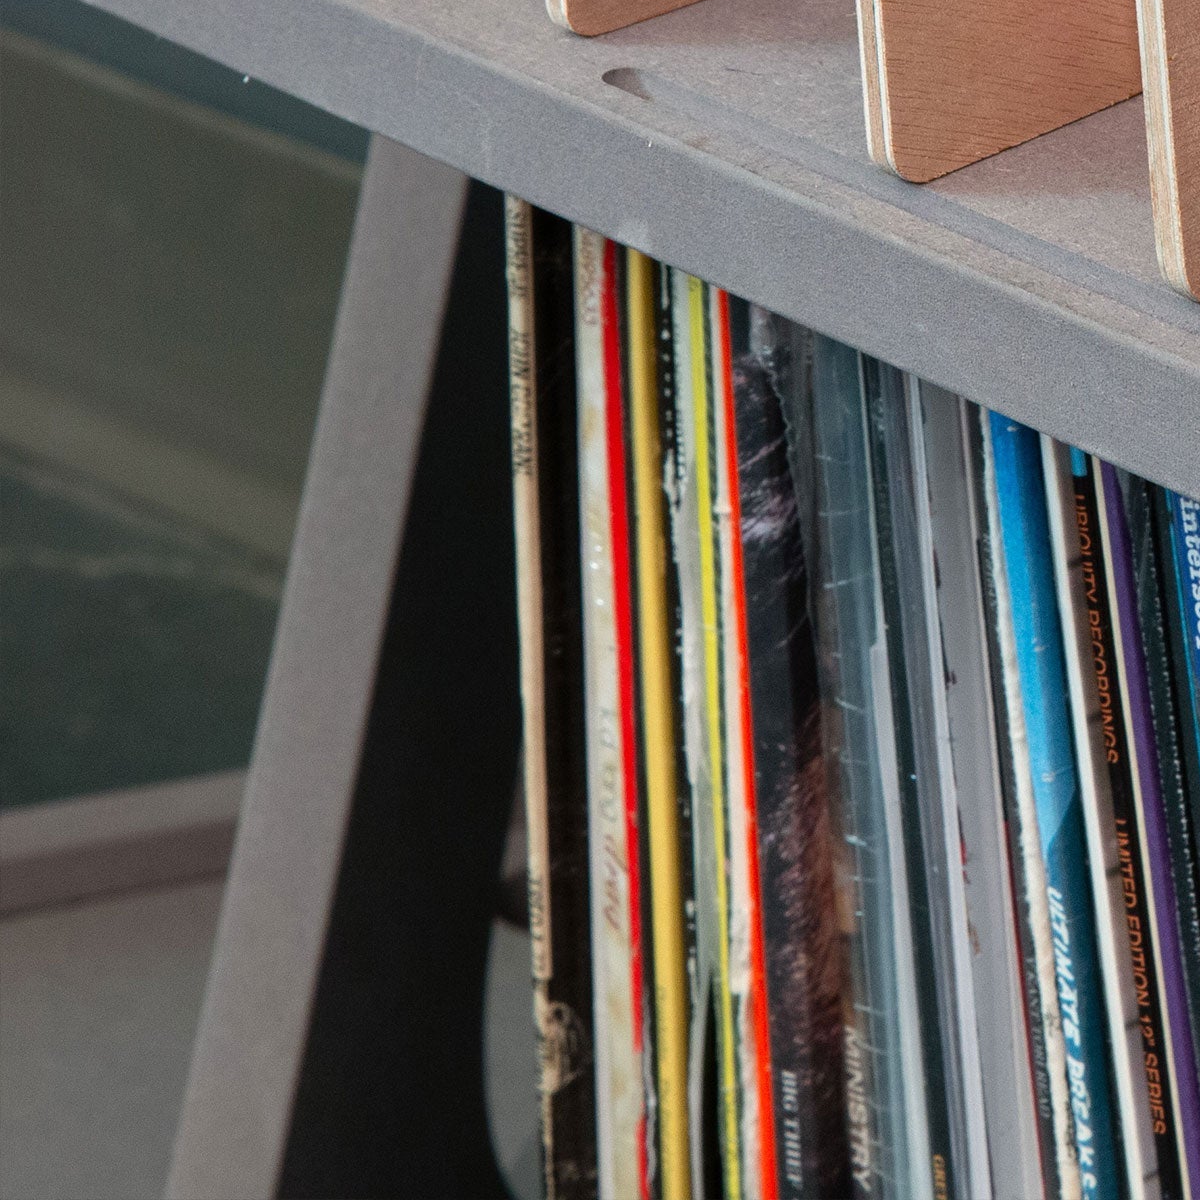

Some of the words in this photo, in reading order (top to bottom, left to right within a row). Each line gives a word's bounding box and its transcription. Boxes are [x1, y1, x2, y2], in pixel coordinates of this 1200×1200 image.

[1088, 609, 1119, 764] RECORDINGS
[1047, 886, 1081, 1047] ULTIMATE
[1115, 819, 1137, 909] LIMITED
[1127, 915, 1150, 1007] EDITION
[1144, 1050, 1167, 1136] SERIES
[845, 1025, 873, 1193] MINISTRY
